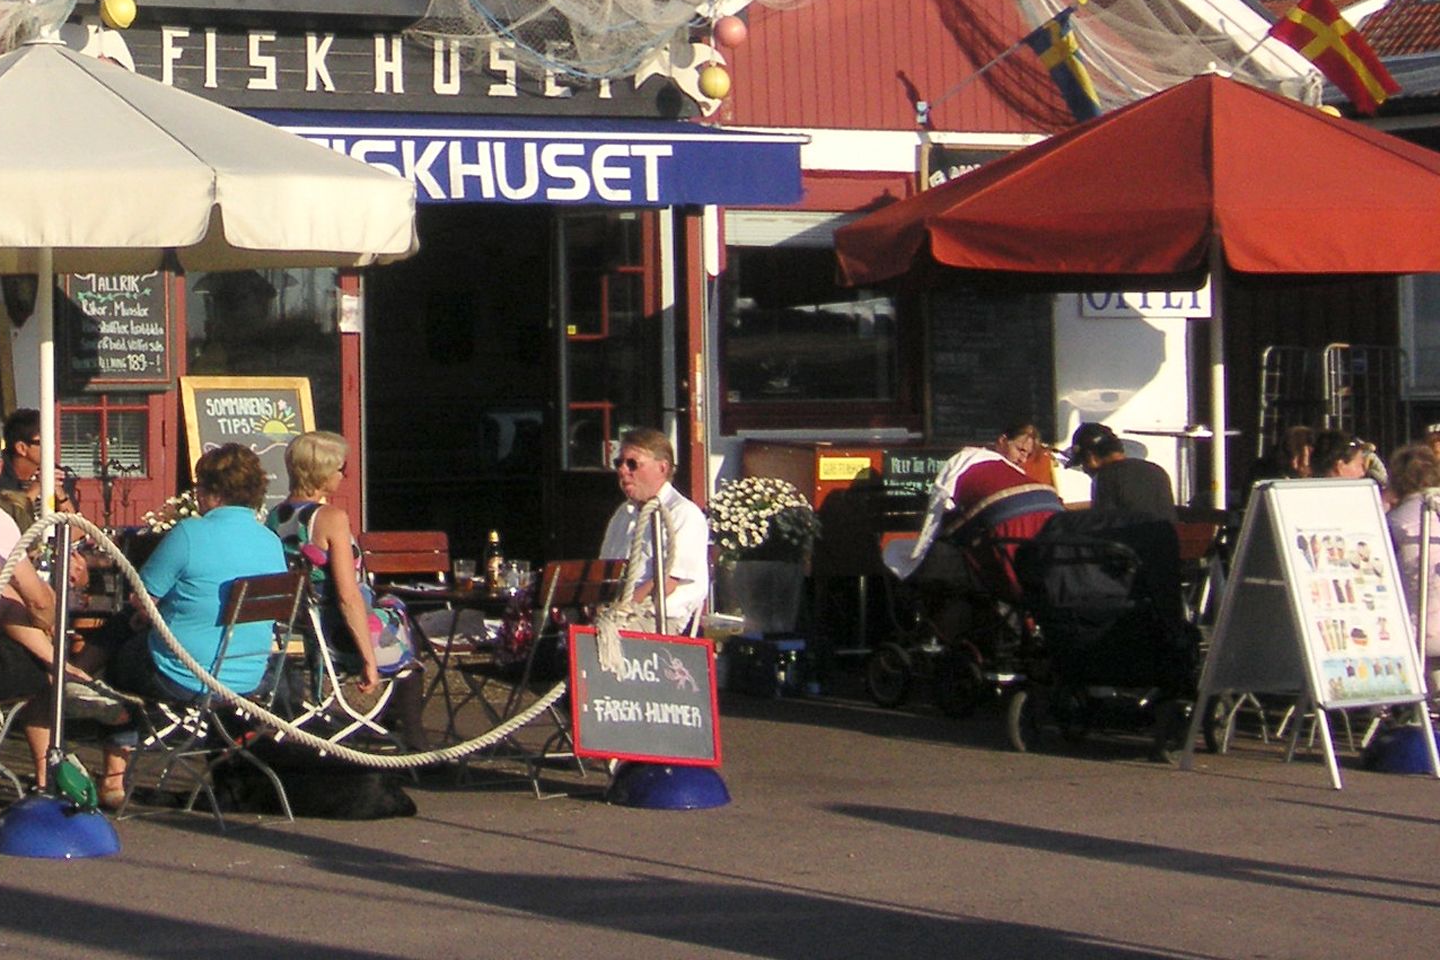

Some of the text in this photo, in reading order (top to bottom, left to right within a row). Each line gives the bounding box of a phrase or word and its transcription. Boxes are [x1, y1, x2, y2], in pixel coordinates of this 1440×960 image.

[74, 272, 141, 294] TALLRIK
[205, 396, 274, 418] SOMMARENS
[217, 417, 257, 435] TIPS!
[592, 694, 703, 729] FÄRSK HUMMER
